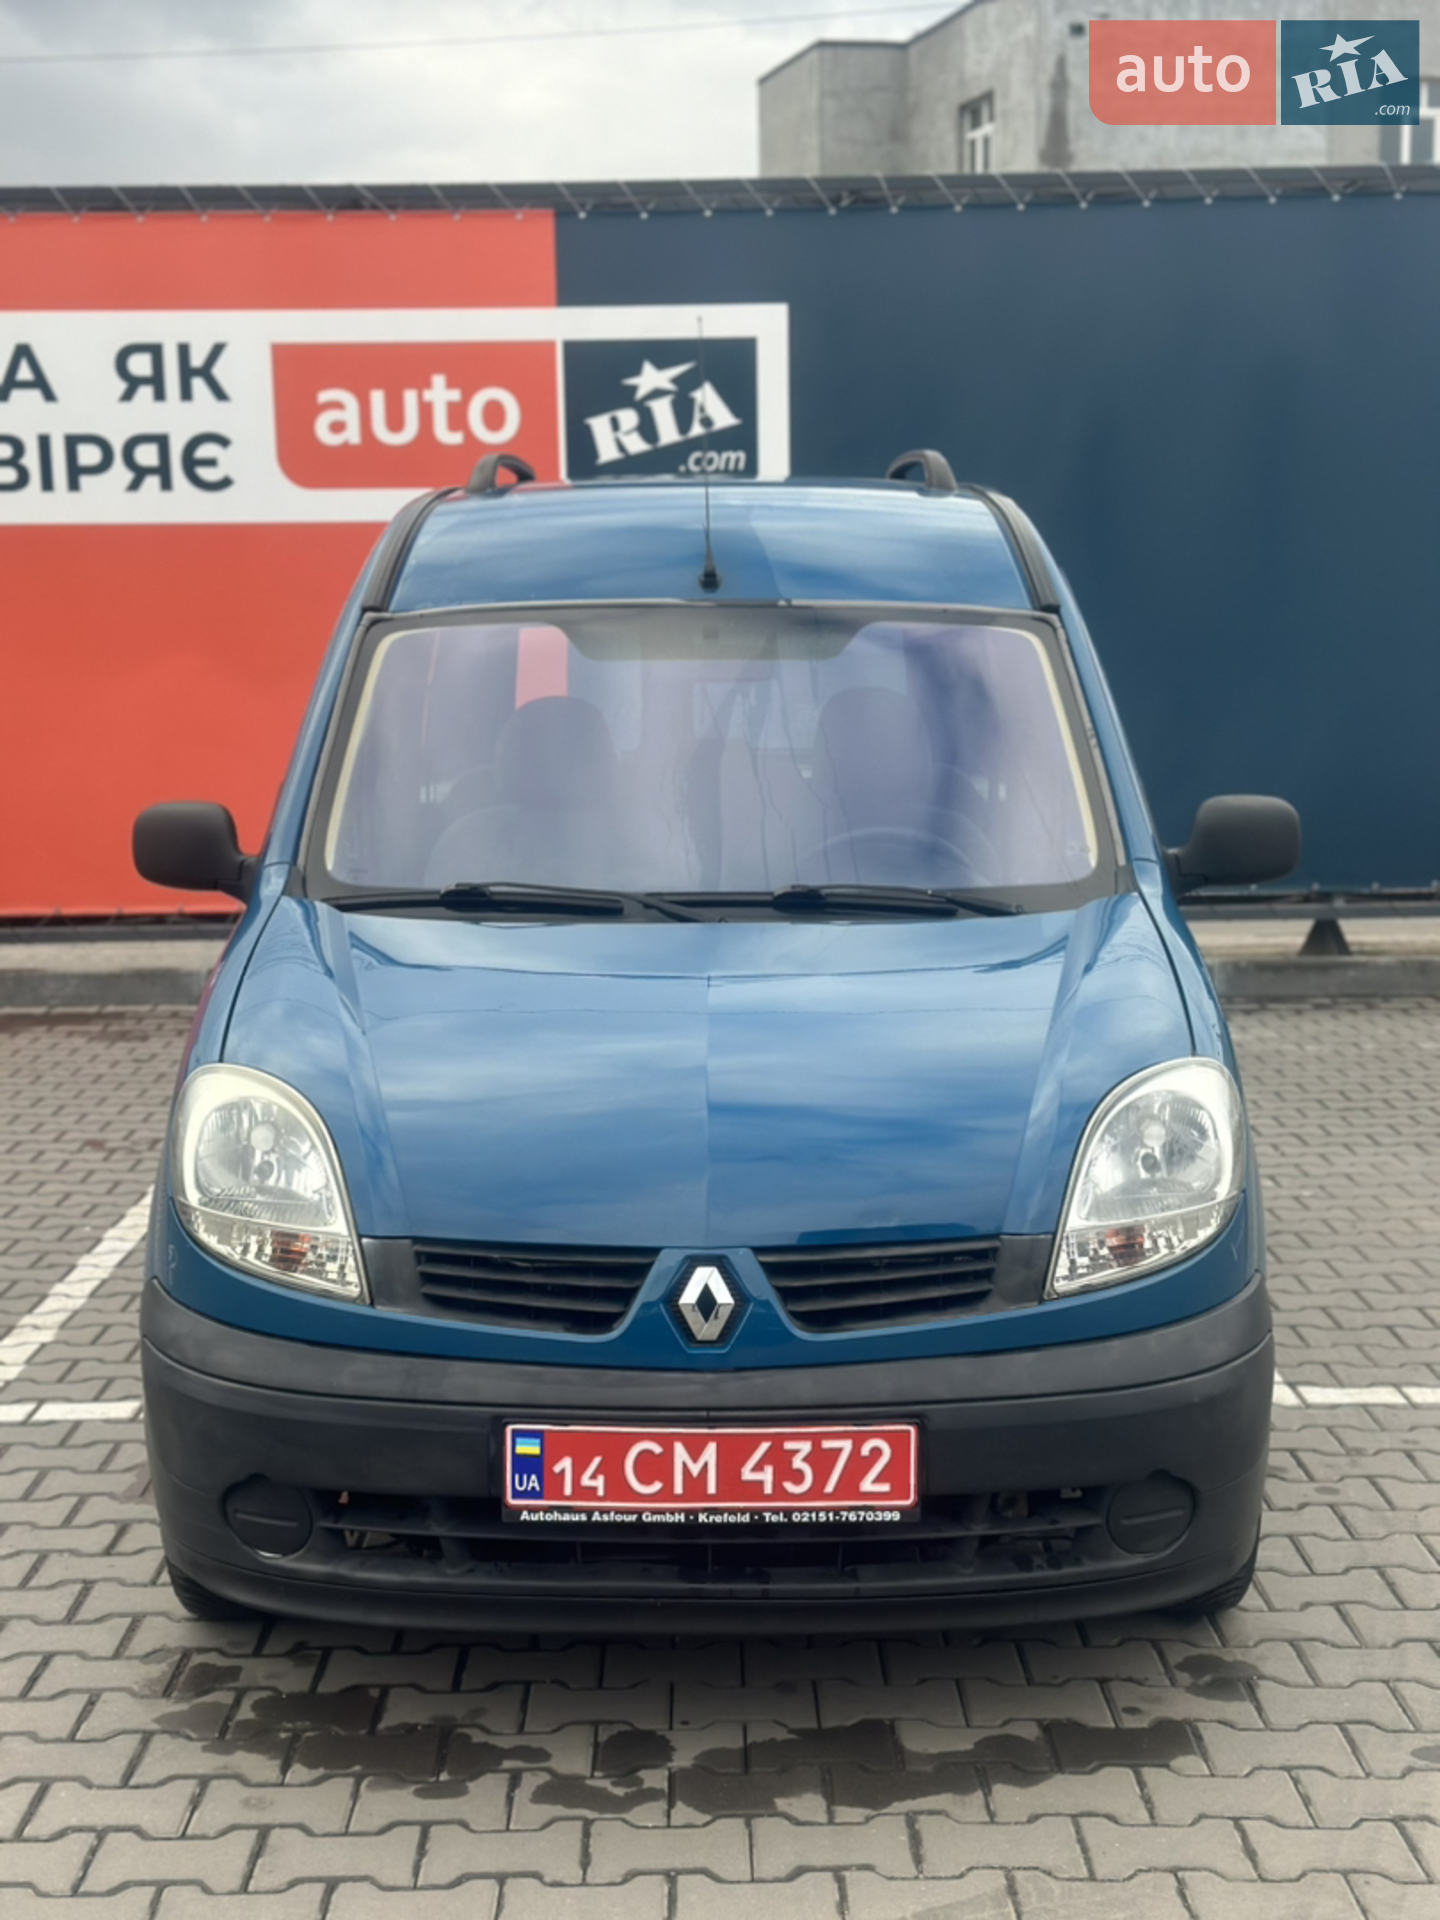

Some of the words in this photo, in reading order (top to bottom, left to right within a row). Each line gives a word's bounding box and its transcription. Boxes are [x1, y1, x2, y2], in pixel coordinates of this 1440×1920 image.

[0, 343, 58, 402] А
[115, 342, 231, 402] ЯК
[313, 374, 522, 447] auto
[584, 380, 743, 465] RIA
[678, 450, 747, 473] .com
[514, 1474, 540, 1491] UA
[552, 1456, 605, 1496] 14
[623, 1440, 717, 1494] CM
[740, 1438, 892, 1494] 4372
[520, 1510, 587, 1522] Autohaus
[592, 1511, 637, 1522] Asfour
[642, 1512, 685, 1523] GmbH
[698, 1512, 750, 1523] Krefeld
[763, 1512, 788, 1522] Tel.
[792, 1511, 901, 1523] 02151-7670399
